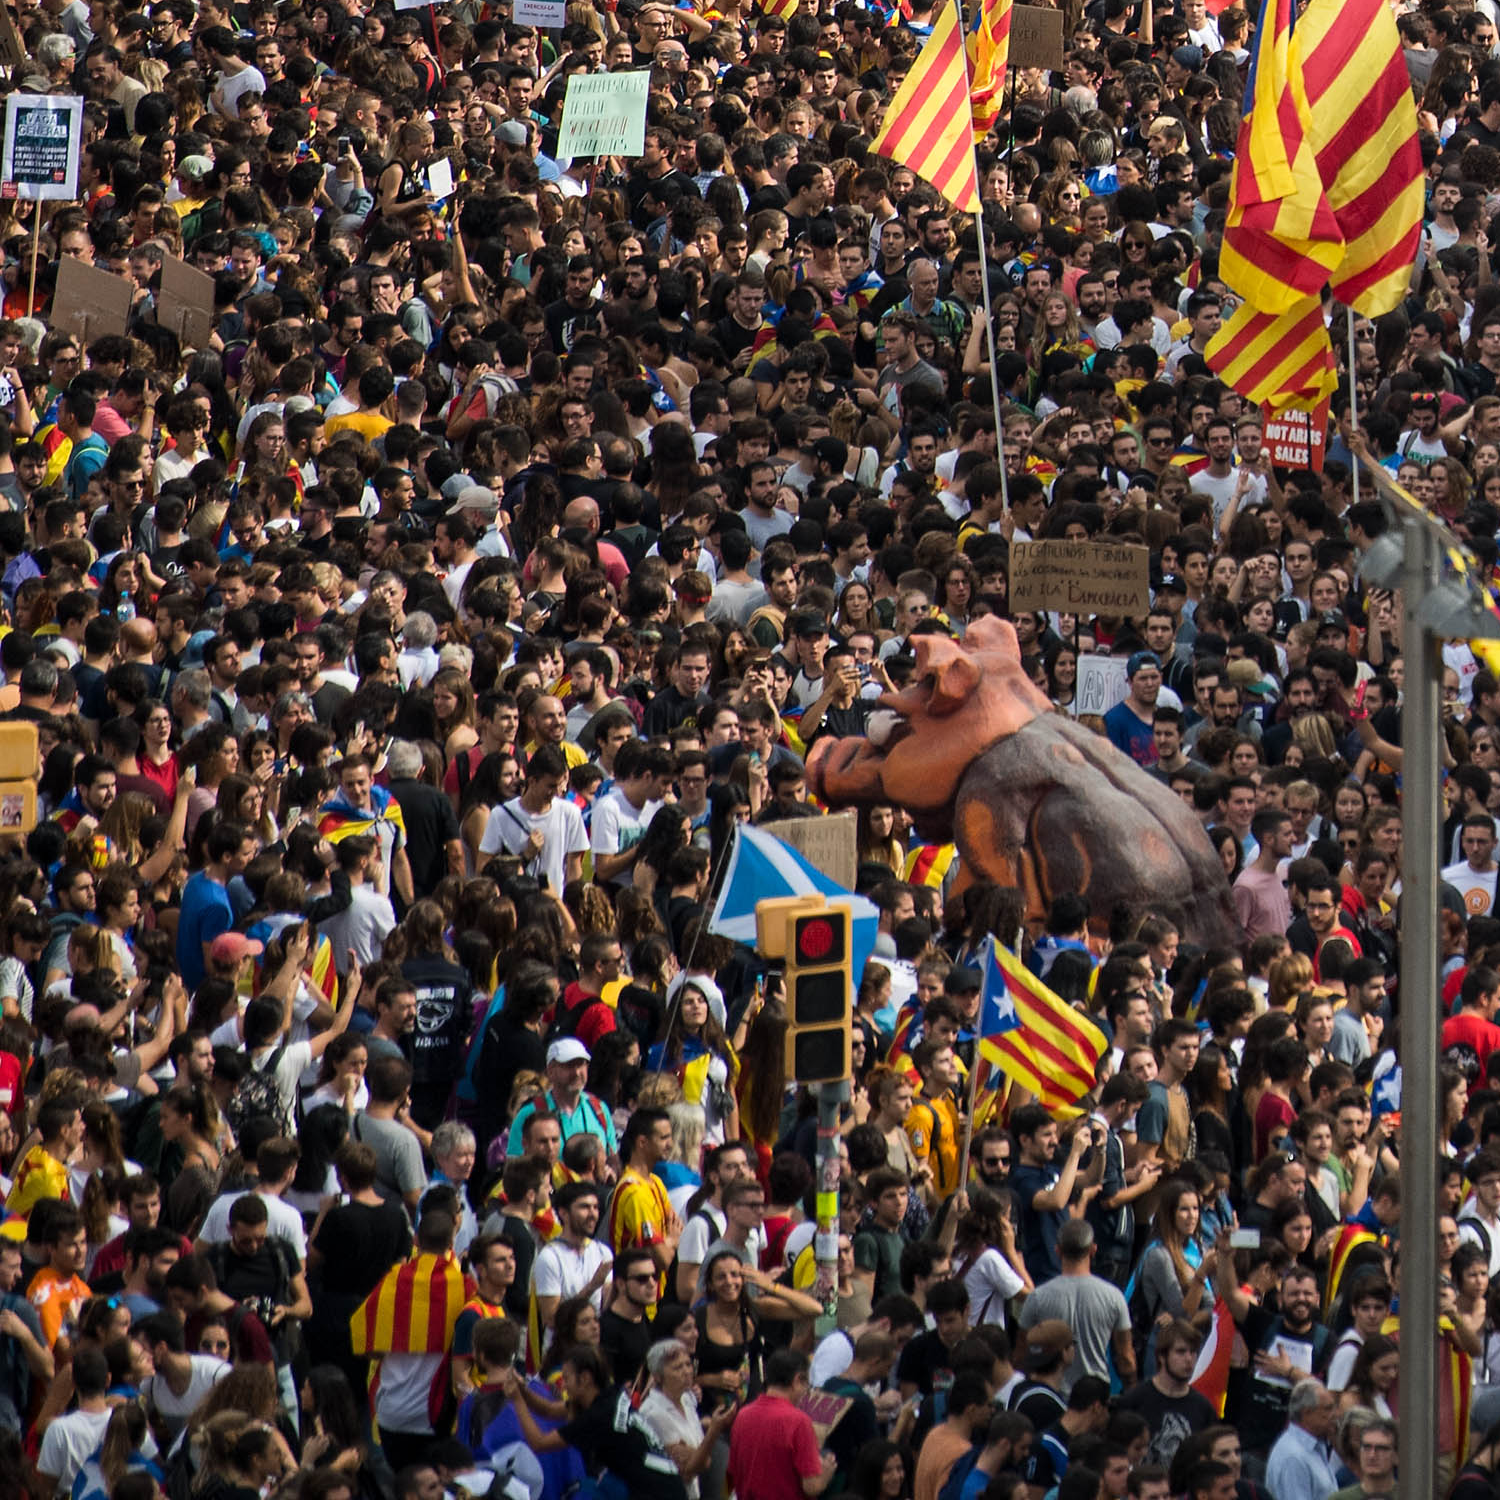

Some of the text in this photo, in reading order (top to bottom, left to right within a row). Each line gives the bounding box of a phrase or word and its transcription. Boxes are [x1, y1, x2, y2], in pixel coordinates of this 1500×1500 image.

[18, 125, 67, 136] GENERAL
[1266, 424, 1289, 439] NOT
[1275, 445, 1309, 463] SALES
